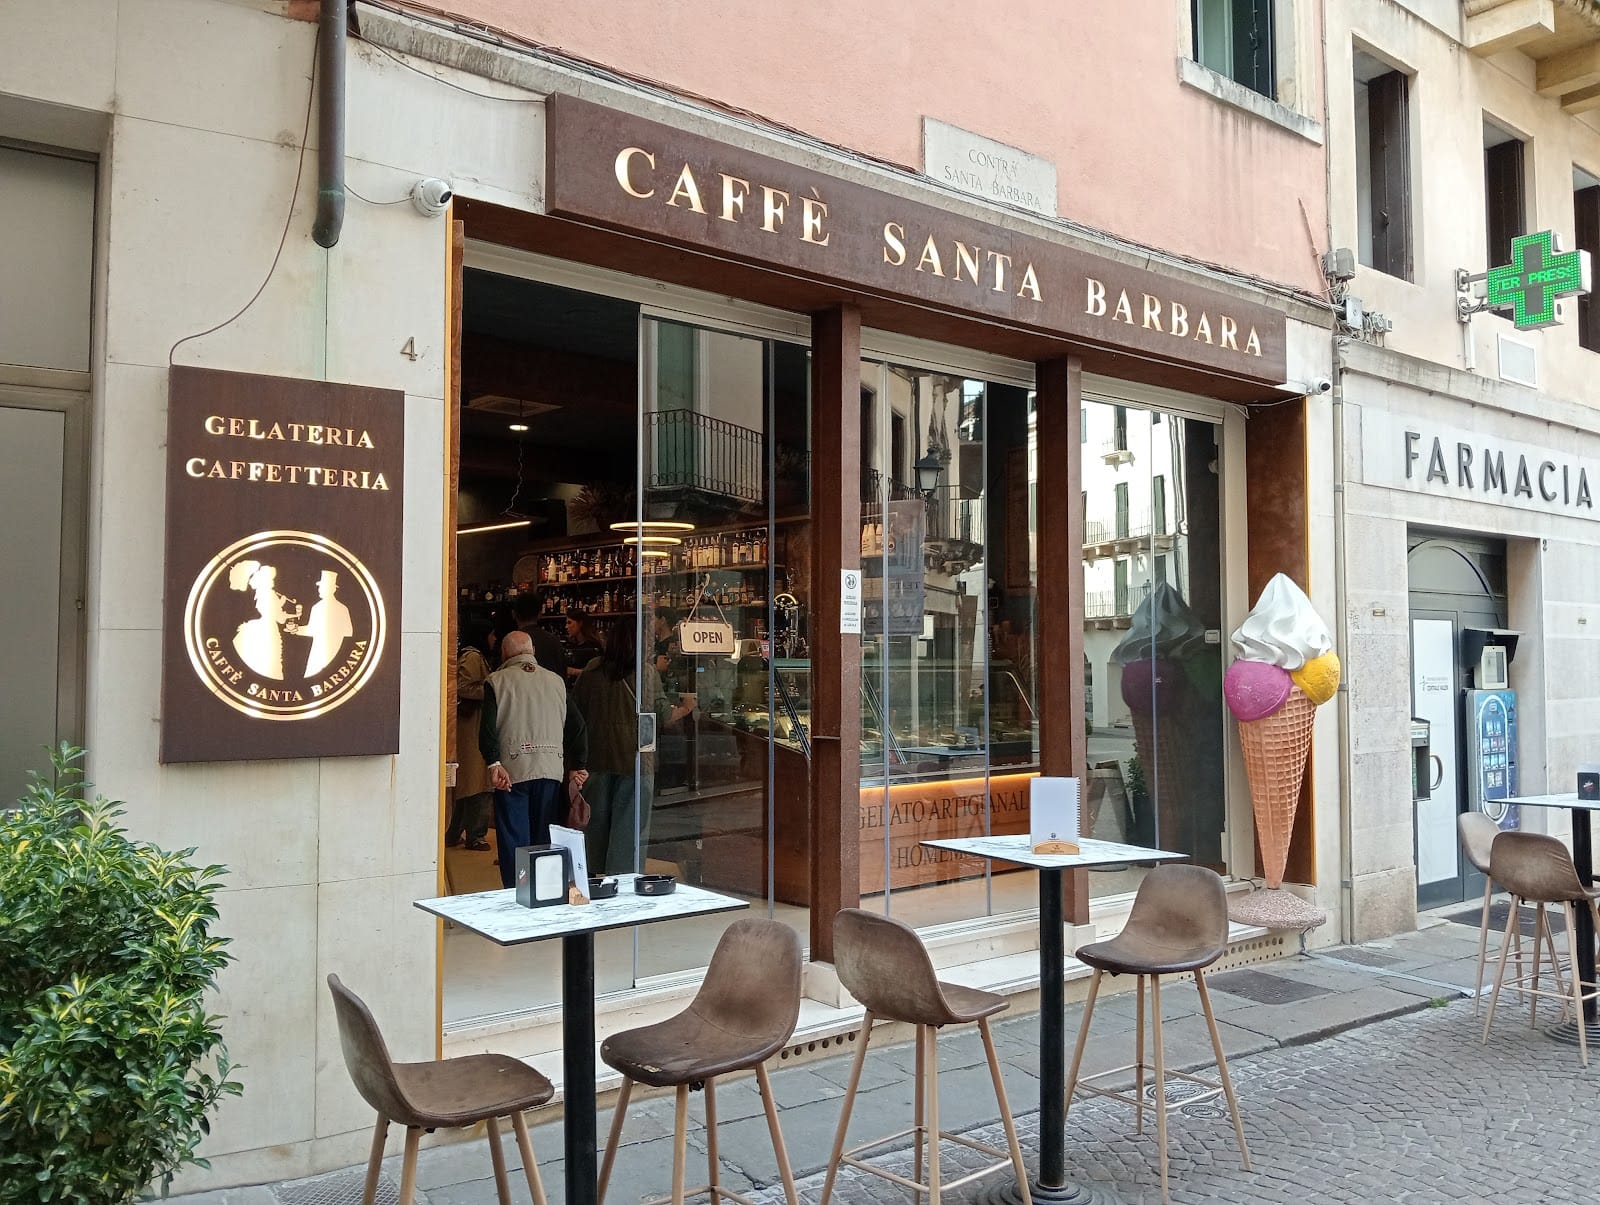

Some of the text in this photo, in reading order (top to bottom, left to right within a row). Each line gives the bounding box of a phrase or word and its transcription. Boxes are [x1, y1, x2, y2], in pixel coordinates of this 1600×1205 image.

[944, 165, 1042, 210] SANTA BARBARA
[614, 146, 1263, 357] CAFFÈ SANTA BARBARA
[400, 336, 418, 361] 4
[204, 415, 375, 449] GELATERIA
[185, 457, 390, 490] CAFFETTERIA
[1405, 431, 1593, 508] FARMACIA
[692, 631, 723, 644] OPEN
[206, 637, 368, 702] CAFFÈ SANTA BARBARA
[928, 790, 1030, 820] ARTIGIANAL
